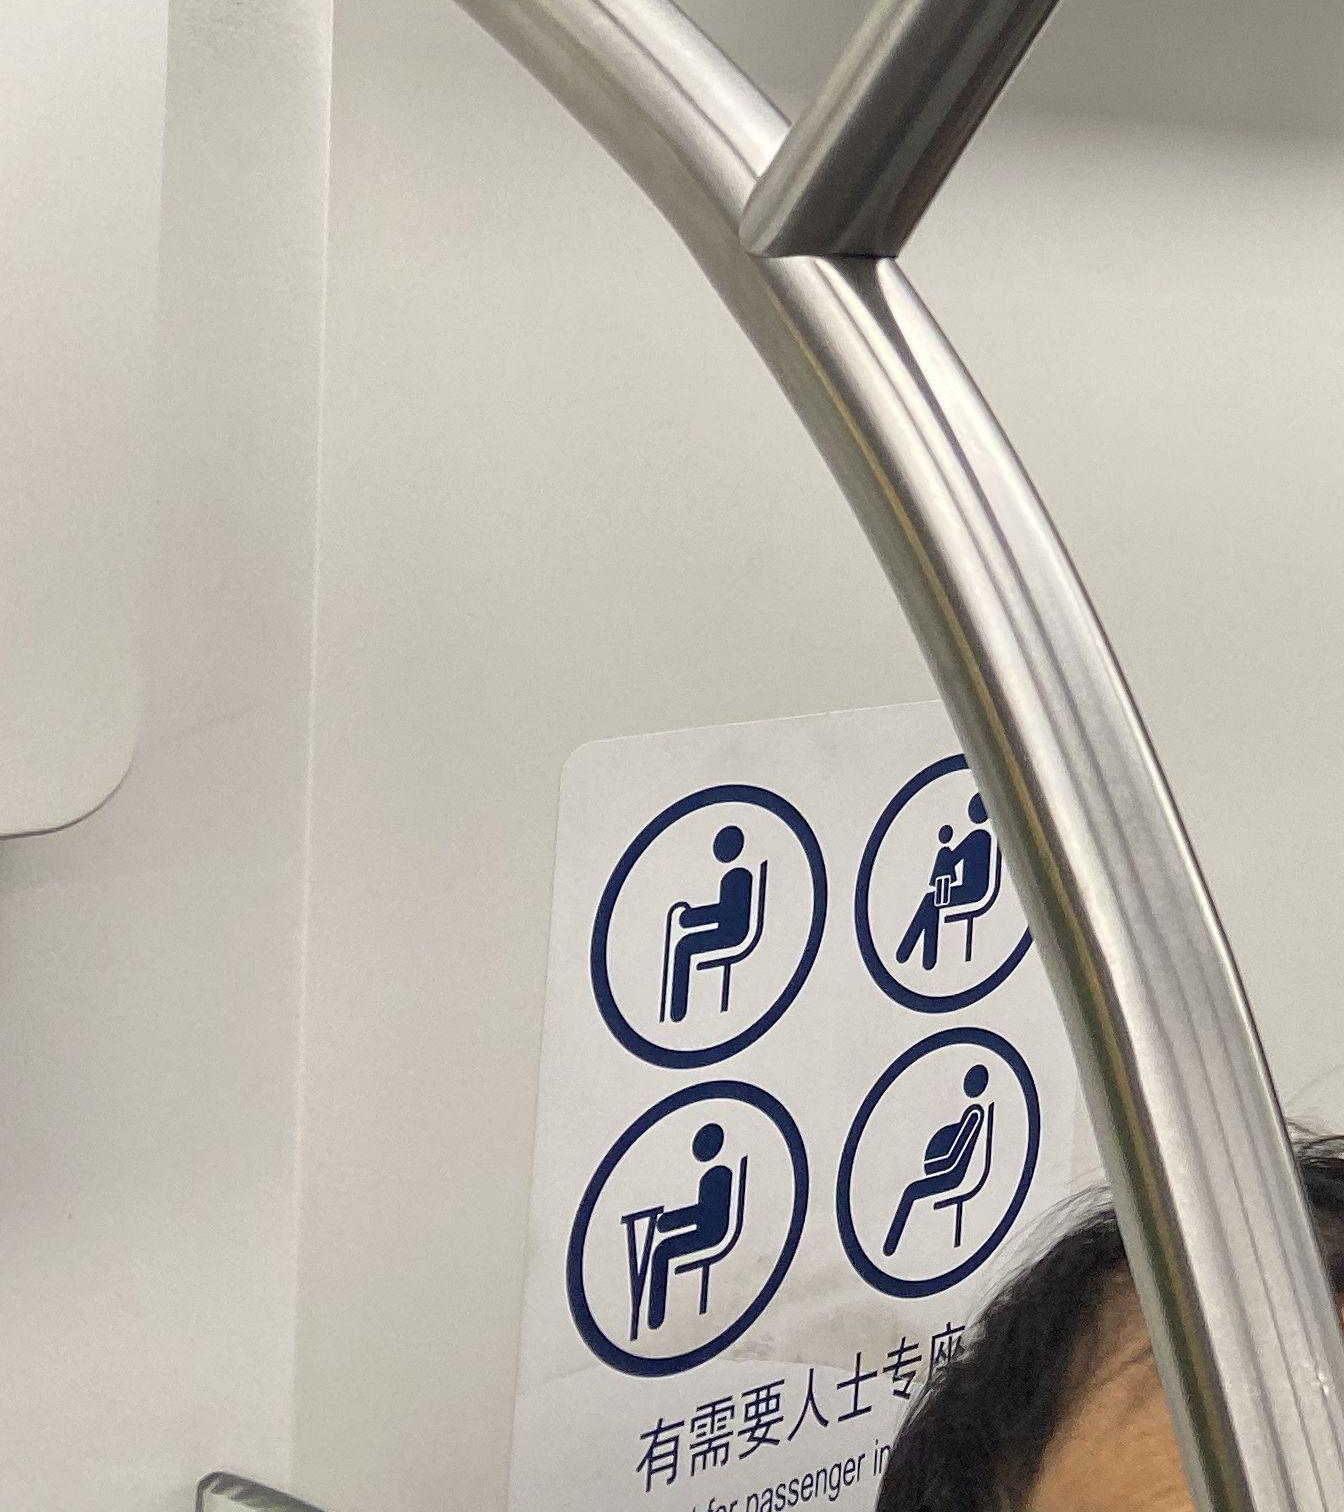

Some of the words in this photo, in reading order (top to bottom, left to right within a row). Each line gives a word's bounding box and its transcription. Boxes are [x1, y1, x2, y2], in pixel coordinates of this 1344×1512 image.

[635, 1321, 966, 1494] 有需要人士专座
[746, 1451, 867, 1512] passenger
